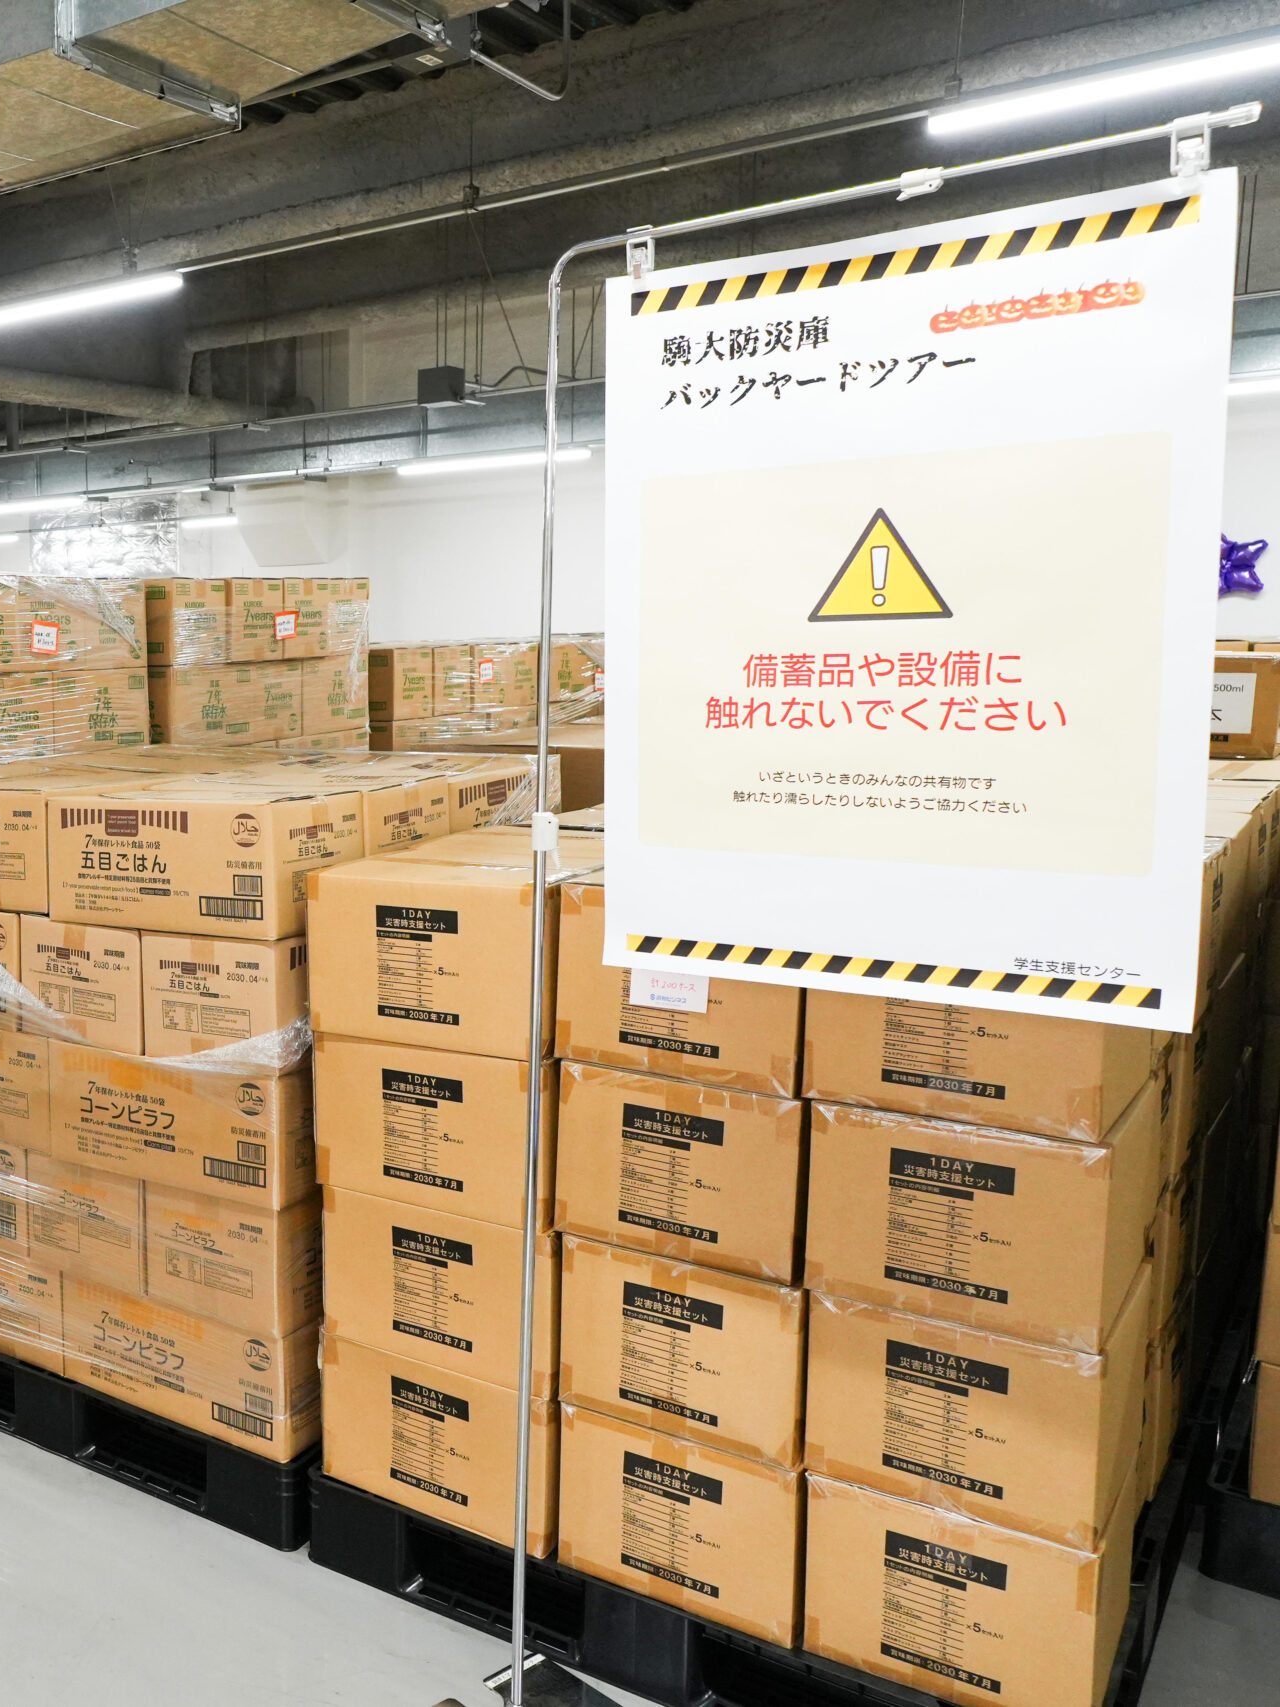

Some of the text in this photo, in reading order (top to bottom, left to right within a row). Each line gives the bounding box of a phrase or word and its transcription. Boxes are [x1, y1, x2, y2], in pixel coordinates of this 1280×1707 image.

[661, 316, 830, 368] 駒大防災庫
[660, 351, 976, 410] バックヤードツアー
[742, 650, 1023, 689] 備蓄品や設備に
[704, 695, 1067, 732] 触れないでください
[758, 770, 997, 790] いざというときのみんなの共有物です
[733, 790, 1028, 815] 触れたり濡らしたりしないようご協力ください
[80, 851, 167, 874] 五目ごはん
[227, 860, 262, 870] 防災備蓄用
[385, 918, 446, 930] 災害時支援セット
[402, 909, 431, 919] 1DAY
[46, 962, 82, 976] 五目ごはん
[1013, 956, 1141, 980] 学生支援センター
[170, 980, 210, 992] 五目ごはん
[392, 1082, 451, 1097] 災害時支援セット
[407, 1075, 437, 1086] 1DAY
[80, 1097, 175, 1130] コーンピラフ
[656, 1112, 691, 1125] 1DAY
[231, 1127, 266, 1140] 防災備蓄用
[634, 1118, 709, 1139] 災害時支援セット
[930, 1158, 975, 1173] 1DAY
[904, 1164, 996, 1188] 災害時支援セット
[401, 1239, 461, 1259] 災害時支援セット
[418, 1234, 446, 1247] 1DAY
[656, 1291, 691, 1307] 1DAY
[634, 1297, 709, 1322] 災害時支援セット
[93, 1325, 185, 1370] コーンピラフ
[926, 1352, 969, 1369] 1DAY
[900, 1357, 990, 1386] 災害時支援セット
[400, 1389, 458, 1414] 災害時支援セット
[416, 1386, 443, 1400] 1DAY
[635, 1467, 707, 1496] 災害時支援セット
[656, 1463, 690, 1480] 1DAY
[899, 1548, 989, 1581] 災害時支援セット
[925, 1545, 968, 1564] 1DAY
